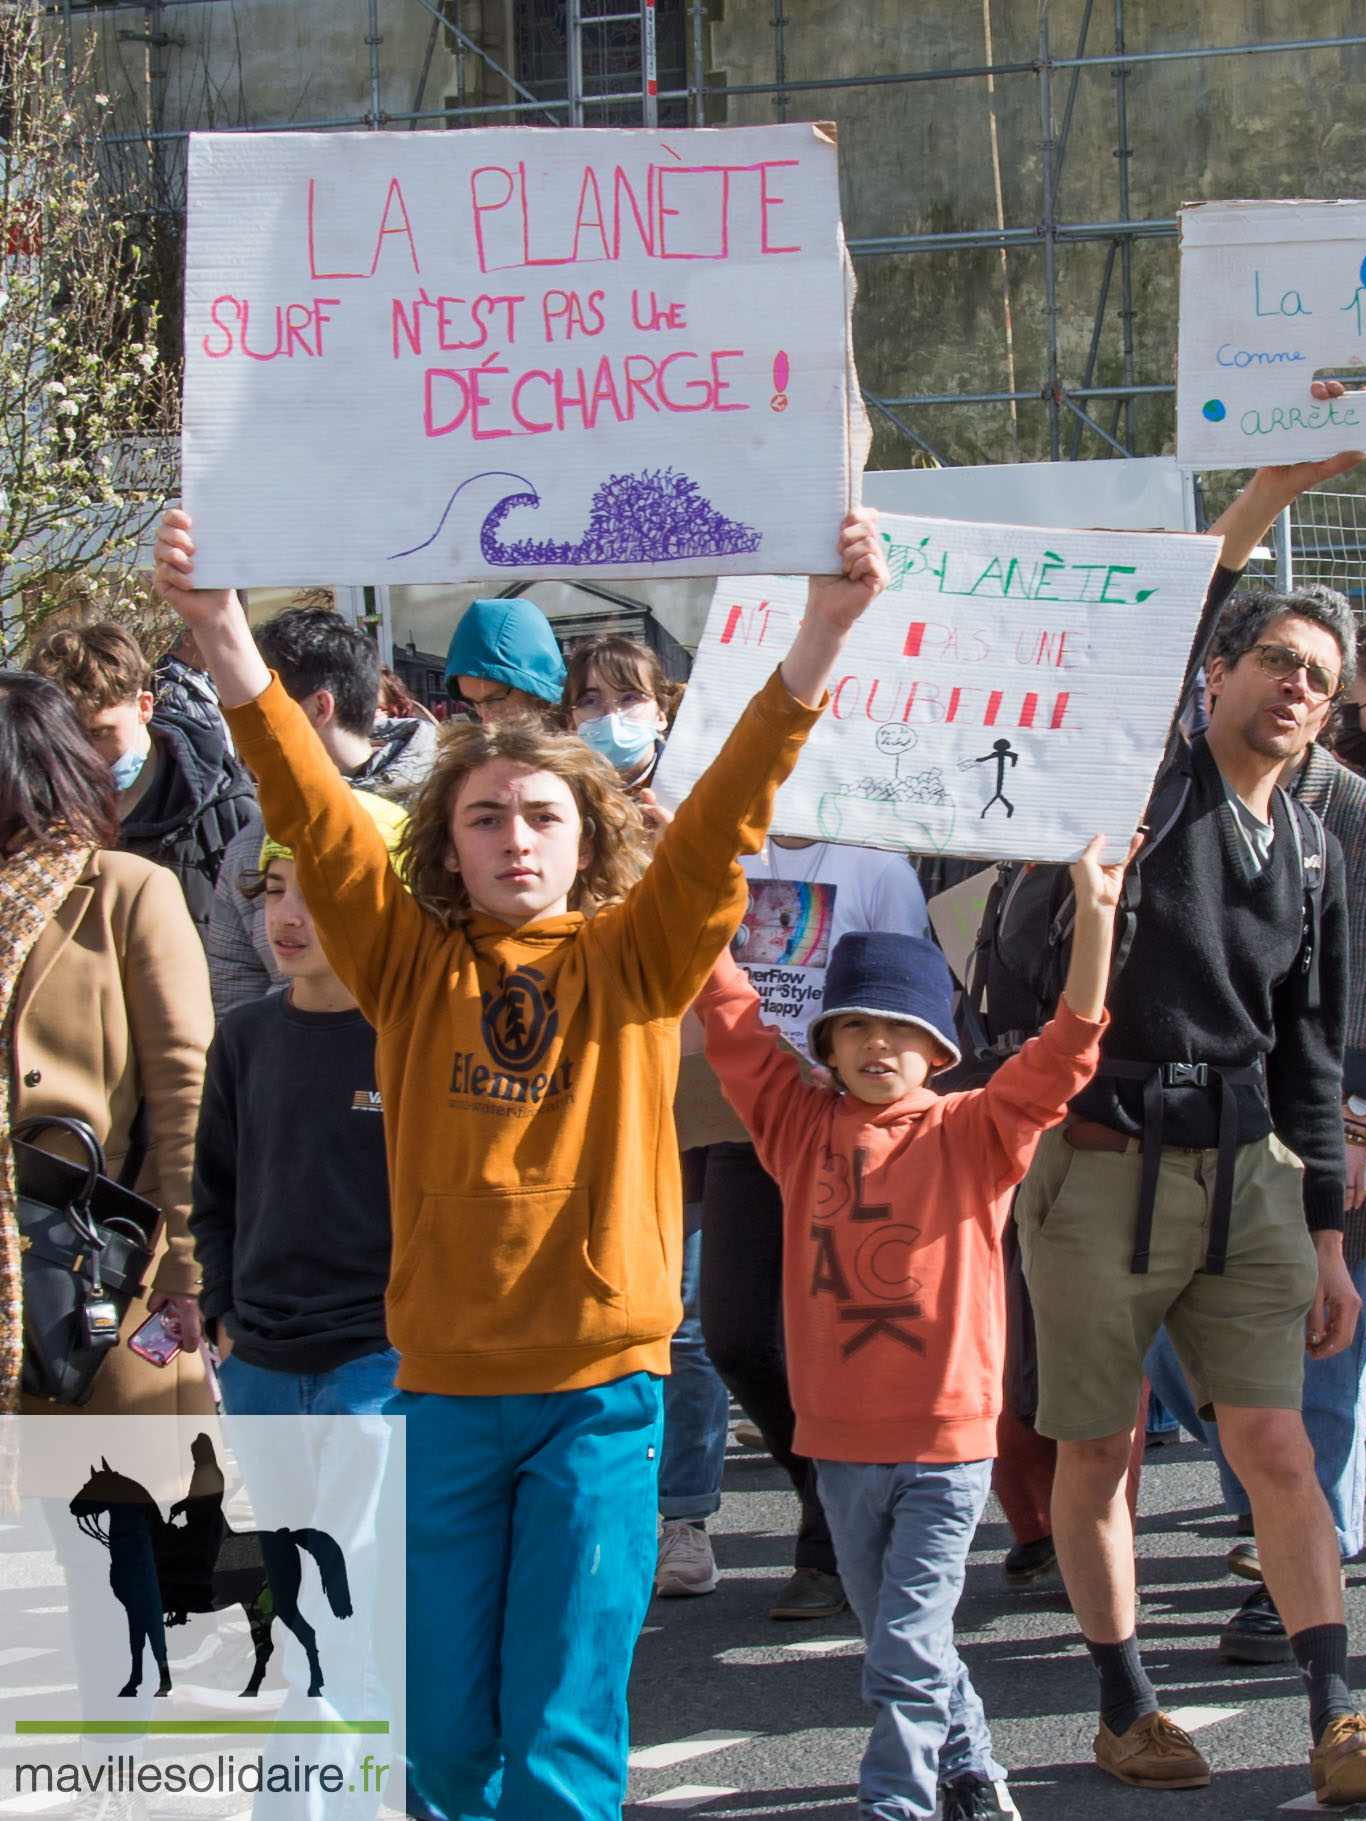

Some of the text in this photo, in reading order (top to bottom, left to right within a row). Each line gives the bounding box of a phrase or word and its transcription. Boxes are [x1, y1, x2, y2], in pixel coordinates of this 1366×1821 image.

[307, 143, 802, 280] LA PLANÈTE
[1254, 270, 1313, 317] La
[203, 294, 342, 361] SURF
[392, 287, 526, 359] N'EST
[542, 289, 606, 342] PAS
[902, 621, 991, 663] PAS
[1014, 630, 1086, 668] UNE
[829, 675, 1090, 730] OUBELLE
